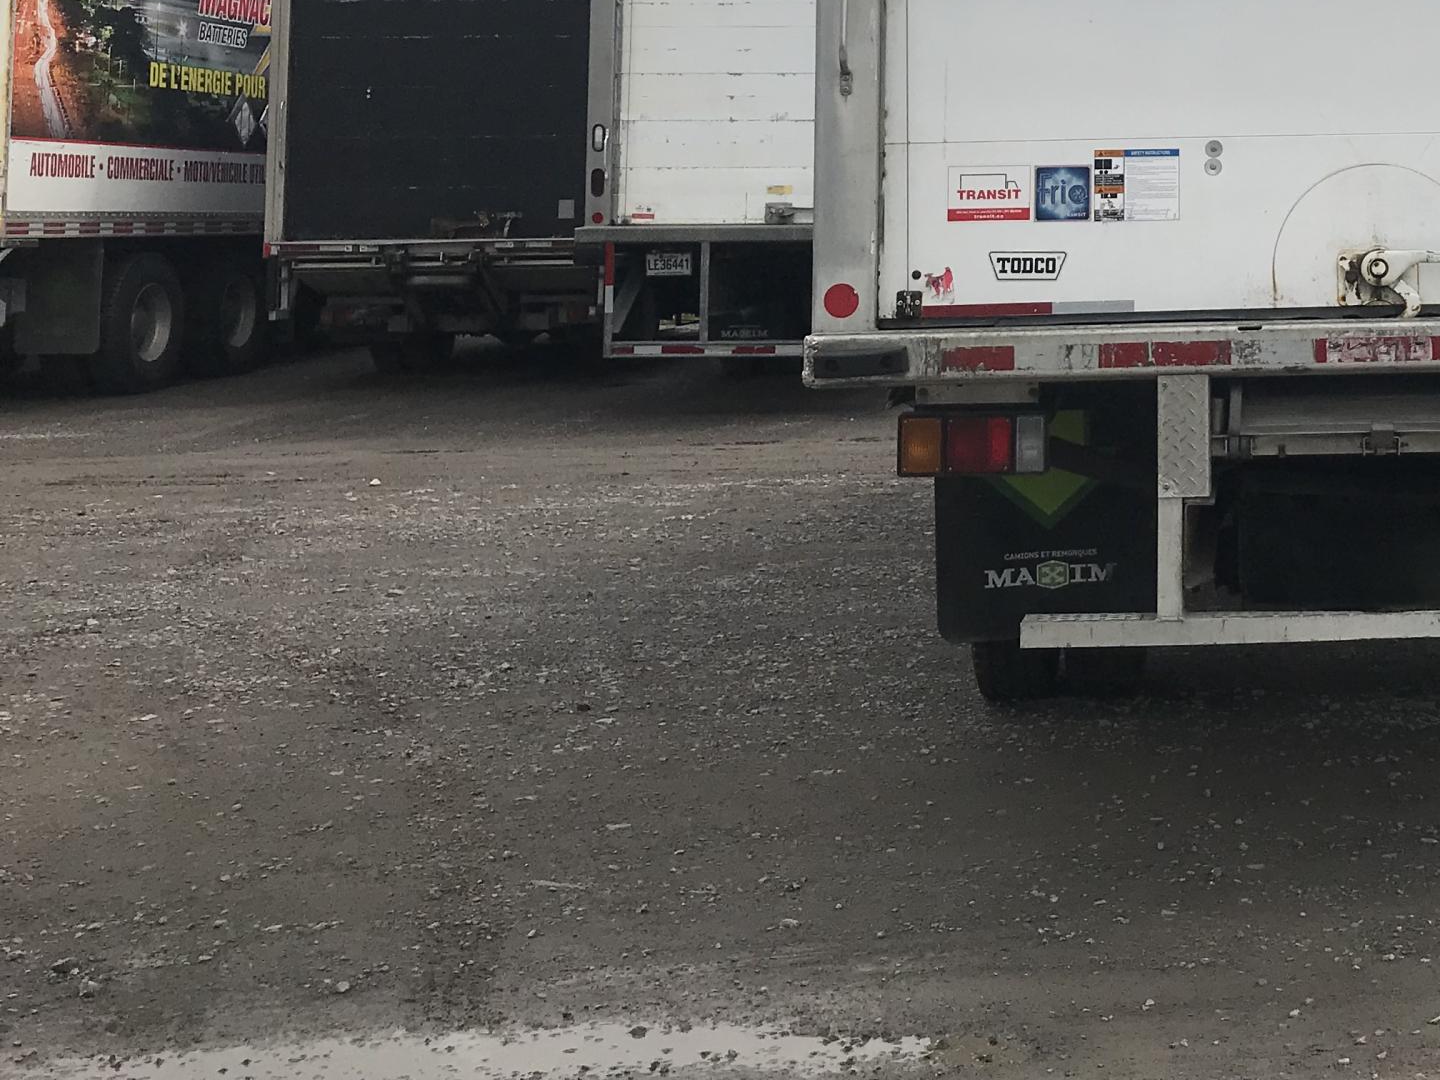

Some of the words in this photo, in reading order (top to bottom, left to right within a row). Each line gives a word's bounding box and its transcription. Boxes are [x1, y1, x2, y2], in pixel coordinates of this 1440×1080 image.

[199, 23, 247, 47] BATTERIES
[149, 62, 166, 88] DE
[170, 64, 232, 96] L'ENERGIE
[235, 73, 266, 99] POUR
[30, 152, 96, 178] AUTOMOBILE
[107, 156, 175, 181] COMMERCIALE
[957, 188, 1022, 200] TRANSIT
[996, 257, 1057, 274] TODCO
[1004, 551, 1039, 560] CAMIONS
[1040, 550, 1050, 558] ET
